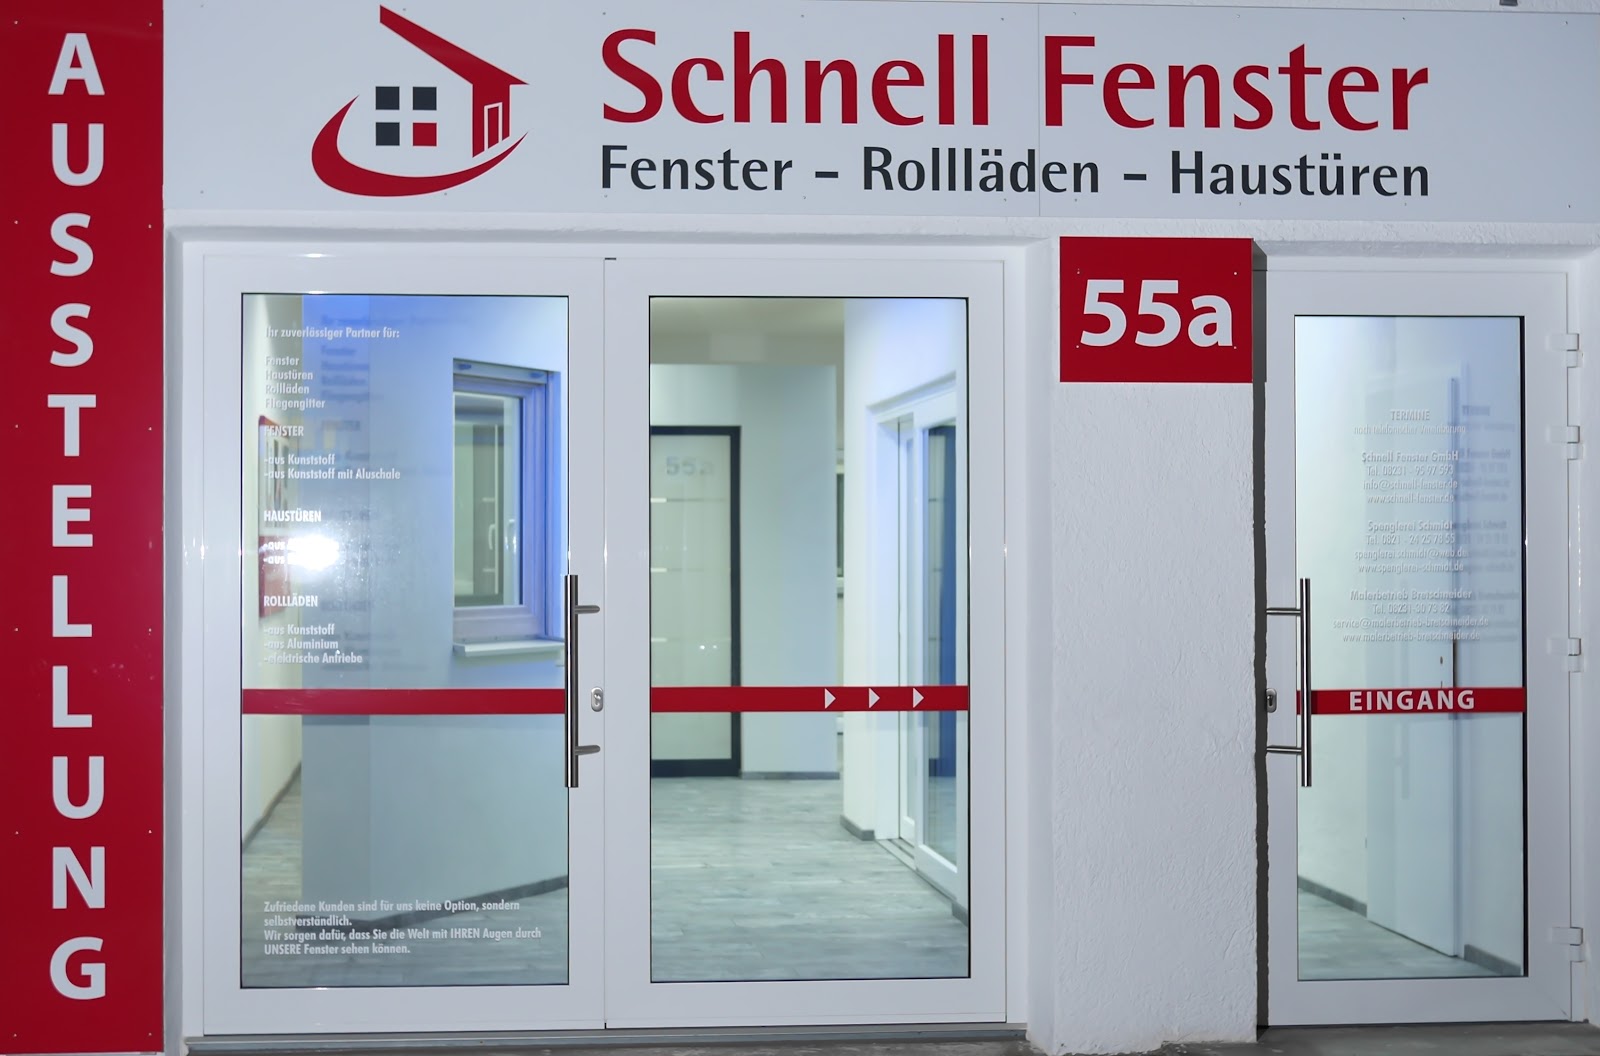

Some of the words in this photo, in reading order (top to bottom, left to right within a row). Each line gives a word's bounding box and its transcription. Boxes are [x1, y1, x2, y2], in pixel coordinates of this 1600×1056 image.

[601, 28, 989, 125] Schnell
[1044, 35, 1429, 131] Fenster
[602, 145, 793, 191] Fenster
[863, 146, 1098, 193] Rollläden
[1171, 151, 1429, 196] Haustüren
[1080, 279, 1233, 347] 55a
[265, 327, 279, 338] Ihr
[281, 326, 343, 341] zuverlässiger
[346, 328, 381, 338] Partner
[383, 327, 400, 339] für:
[265, 356, 300, 367] Fenster
[265, 369, 314, 381] Haustüren
[265, 383, 310, 395] Rollläden
[265, 397, 326, 411] Fliegengitter
[1390, 408, 1430, 421] TERMINE
[264, 425, 304, 437] FENSTER
[264, 455, 286, 466] -aus
[288, 454, 336, 466] Kunststoff
[1361, 451, 1394, 463] Schnell
[1396, 451, 1428, 463] Fenster
[1431, 450, 1459, 462] GmbH
[264, 469, 286, 480] -aus
[288, 468, 336, 480] Kunststoff
[337, 468, 354, 480] mit
[355, 468, 401, 480] Aluschale
[1366, 465, 1380, 476] Tel.
[1363, 479, 1458, 491] info@schnell-fenster.de
[48, 32, 106, 1000] AUSSTELLUNG
[264, 507, 322, 523] HAUSTÜREN
[1368, 521, 1416, 534] Spenglerei
[1418, 520, 1454, 531] Schmidt
[1366, 535, 1380, 546] Tel.
[264, 594, 318, 608] ROLLLÄDEN
[1350, 589, 1408, 601] Malerbetrieb
[1411, 588, 1473, 600] Bretschneider
[1373, 604, 1385, 615] Tel.
[264, 626, 286, 636] -aus
[287, 624, 336, 636] Kunststoff
[264, 639, 286, 650] -aus
[287, 638, 339, 650] Aluminium
[264, 652, 320, 665] -elektrische
[321, 652, 363, 665] Antriebe
[1349, 690, 1475, 711] EINGANG
[264, 901, 316, 913] Zufriedene
[318, 901, 355, 912] Kunden
[357, 900, 378, 912] sind
[379, 900, 395, 912] für
[396, 903, 413, 912] uns
[415, 900, 441, 911] keine
[444, 900, 480, 913] Option,
[481, 899, 520, 911] sondern
[264, 915, 353, 927] selbstverständlich.
[264, 929, 282, 941] Wir
[283, 932, 317, 943] sorgen
[319, 929, 346, 942] dafür,
[348, 929, 370, 940] dass
[372, 929, 388, 940] Sie
[390, 928, 406, 940] die
[407, 928, 430, 940] Welt
[432, 928, 449, 940] mit
[450, 928, 480, 939] IHREN
[482, 928, 513, 942] Augen
[515, 927, 542, 939] durch
[264, 944, 301, 956] UNSERE
[303, 943, 339, 955] Fenster
[341, 943, 370, 955] sehen
[371, 943, 411, 955] können.
